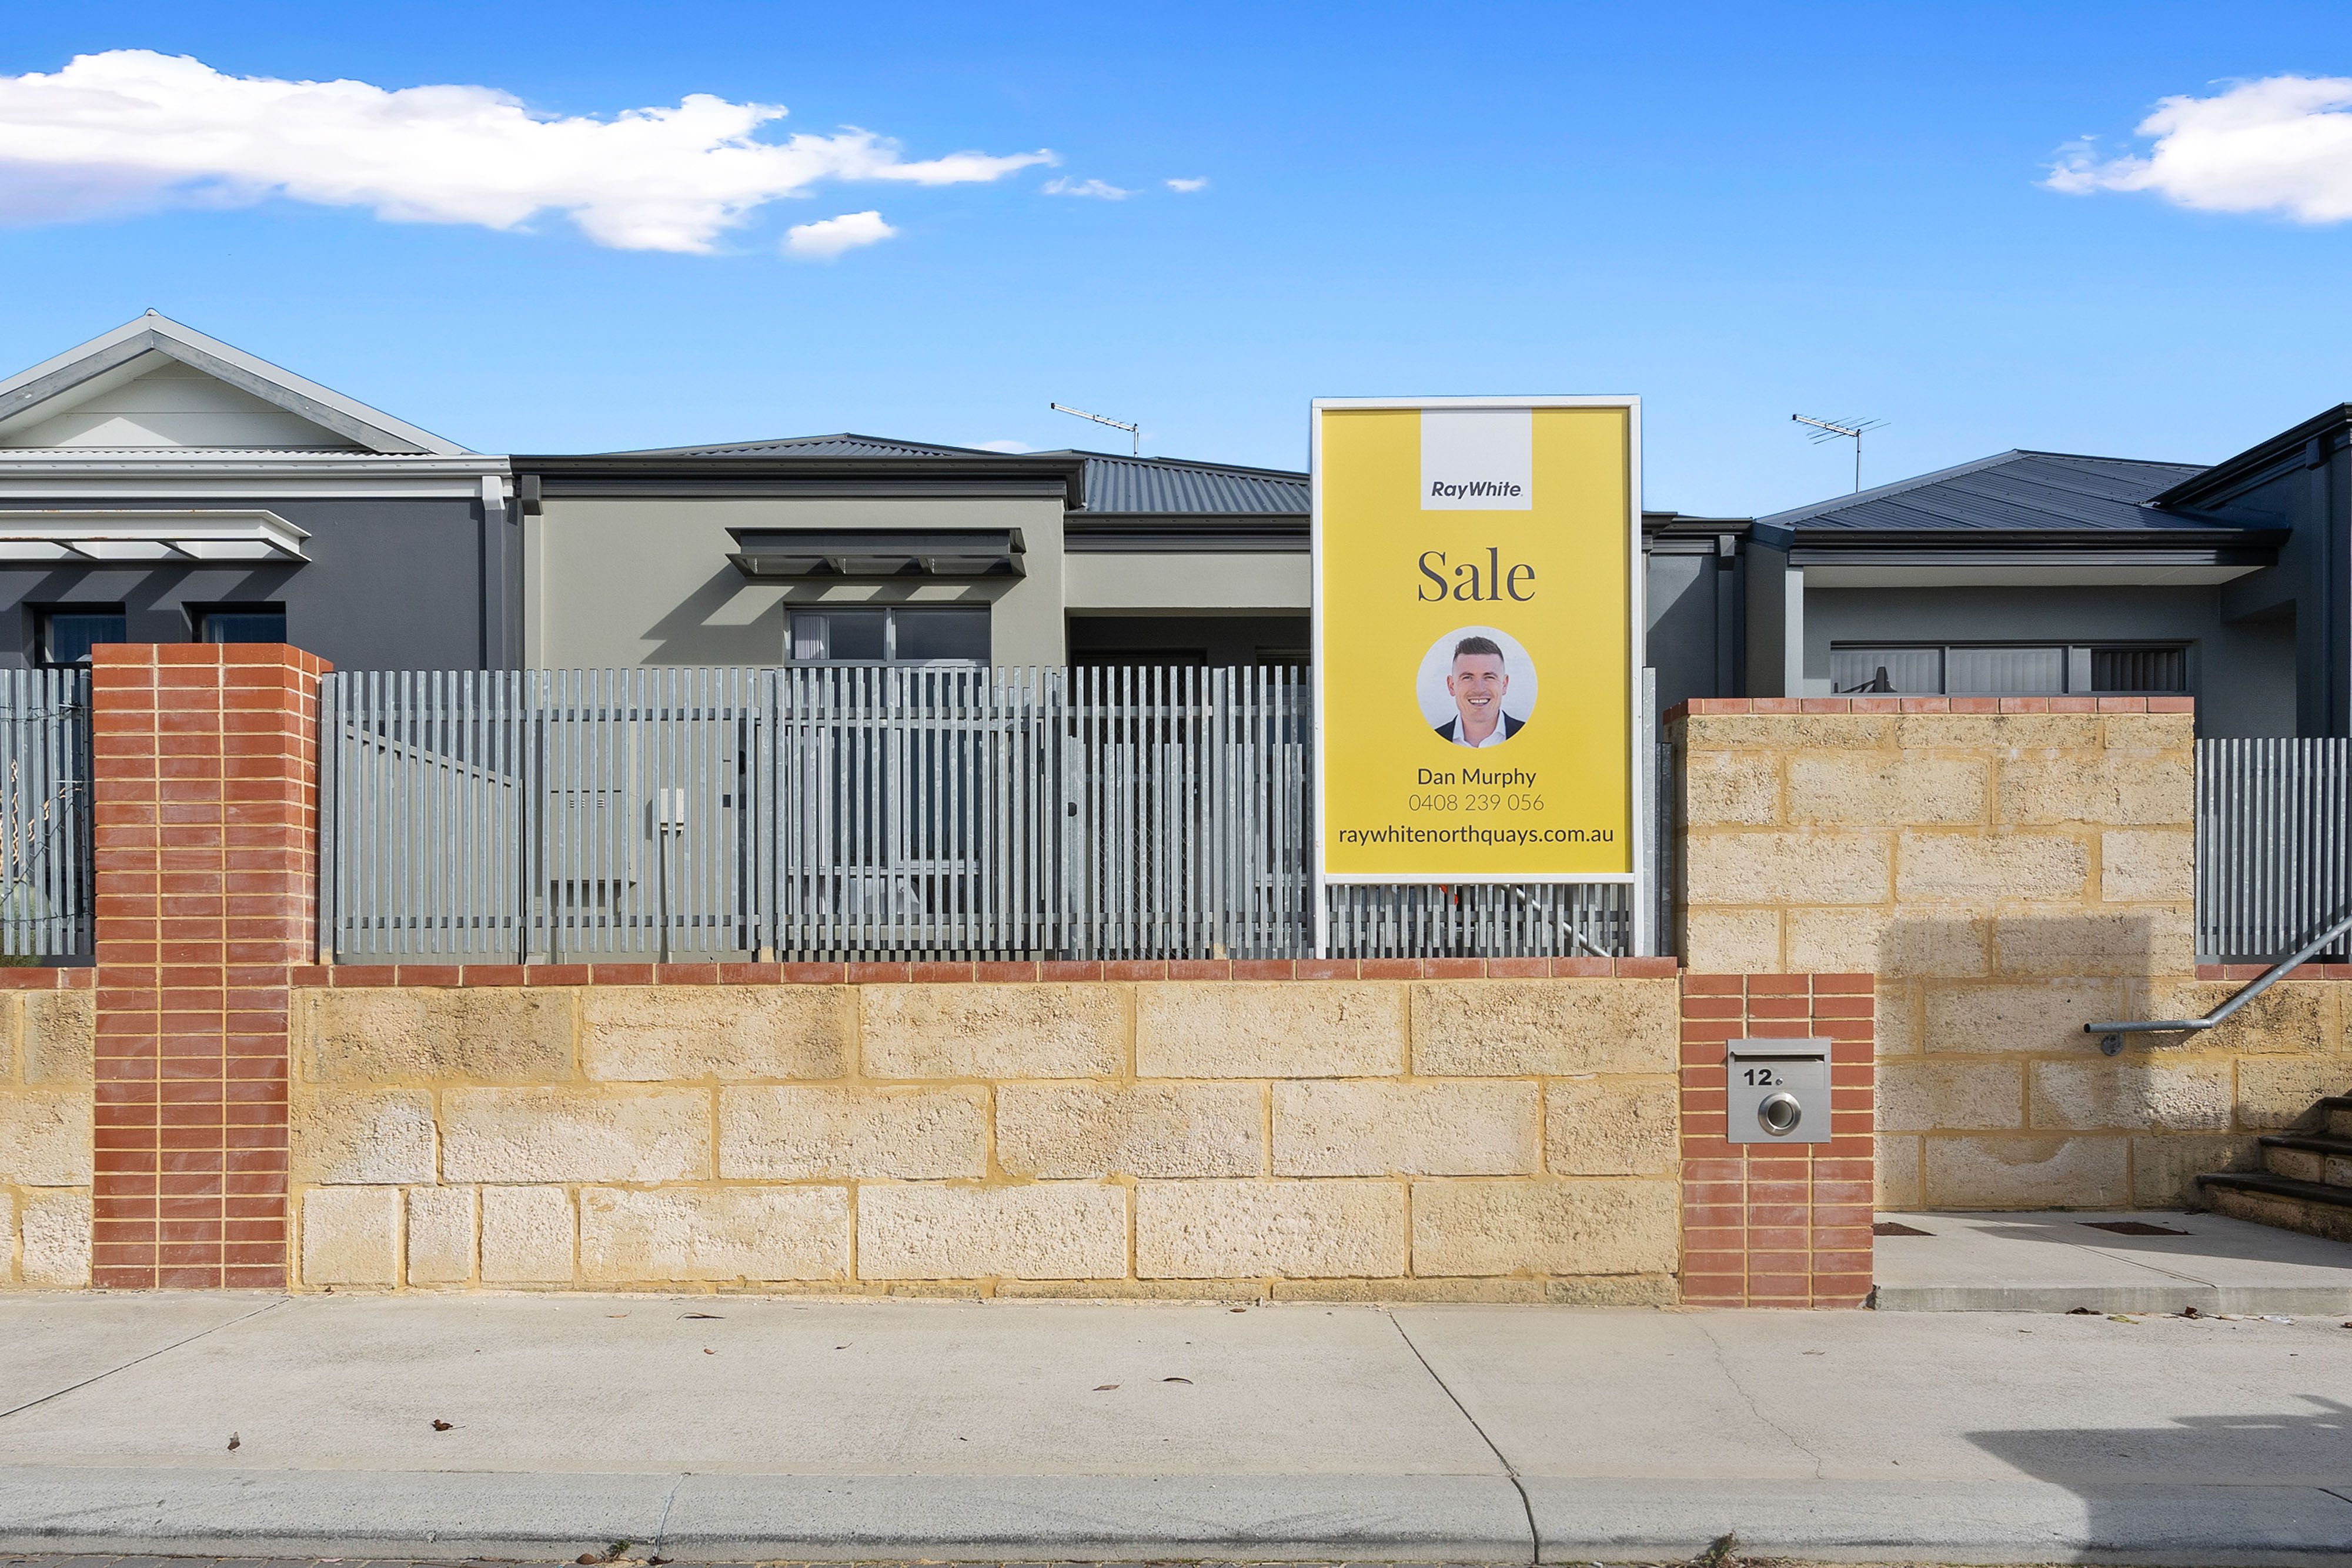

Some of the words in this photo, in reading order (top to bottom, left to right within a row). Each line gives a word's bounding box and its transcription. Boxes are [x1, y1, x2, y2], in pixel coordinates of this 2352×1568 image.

[1418, 547, 1536, 602] Sale
[1418, 768, 1455, 785] Dan
[1462, 767, 1537, 788] Murphy
[1409, 794, 1458, 811] 0408
[1465, 794, 1501, 811] 239
[1507, 794, 1545, 811] 056
[1339, 824, 1613, 847] raywhitenorthquays.com.au
[1743, 1069, 1772, 1086] 12
